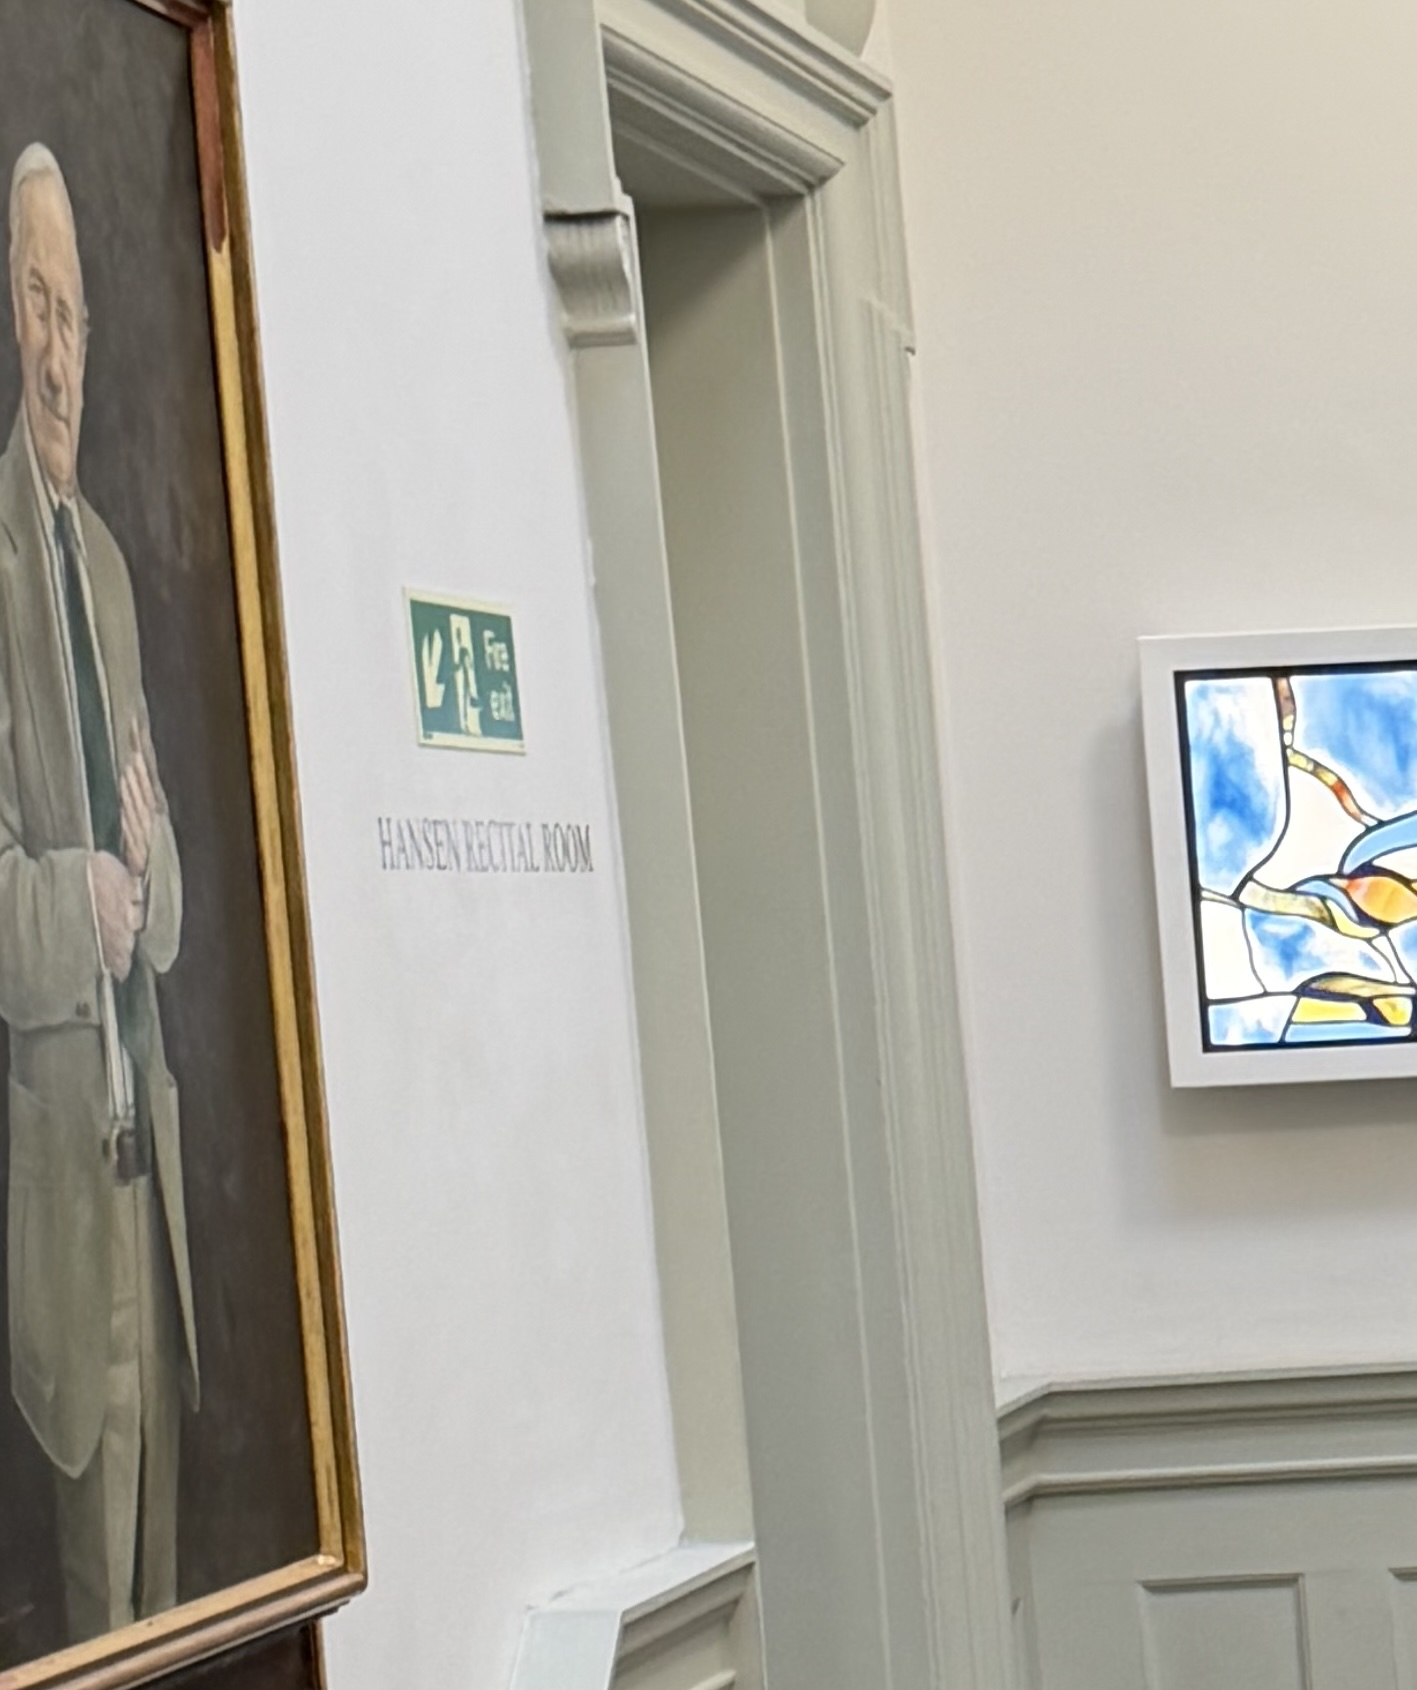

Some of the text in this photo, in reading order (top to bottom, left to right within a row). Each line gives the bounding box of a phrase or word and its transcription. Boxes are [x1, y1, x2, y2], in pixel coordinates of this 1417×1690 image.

[483, 628, 509, 671] Fire
[489, 680, 515, 722] exit
[378, 816, 594, 873] HANSEN RECITAL ROOM
